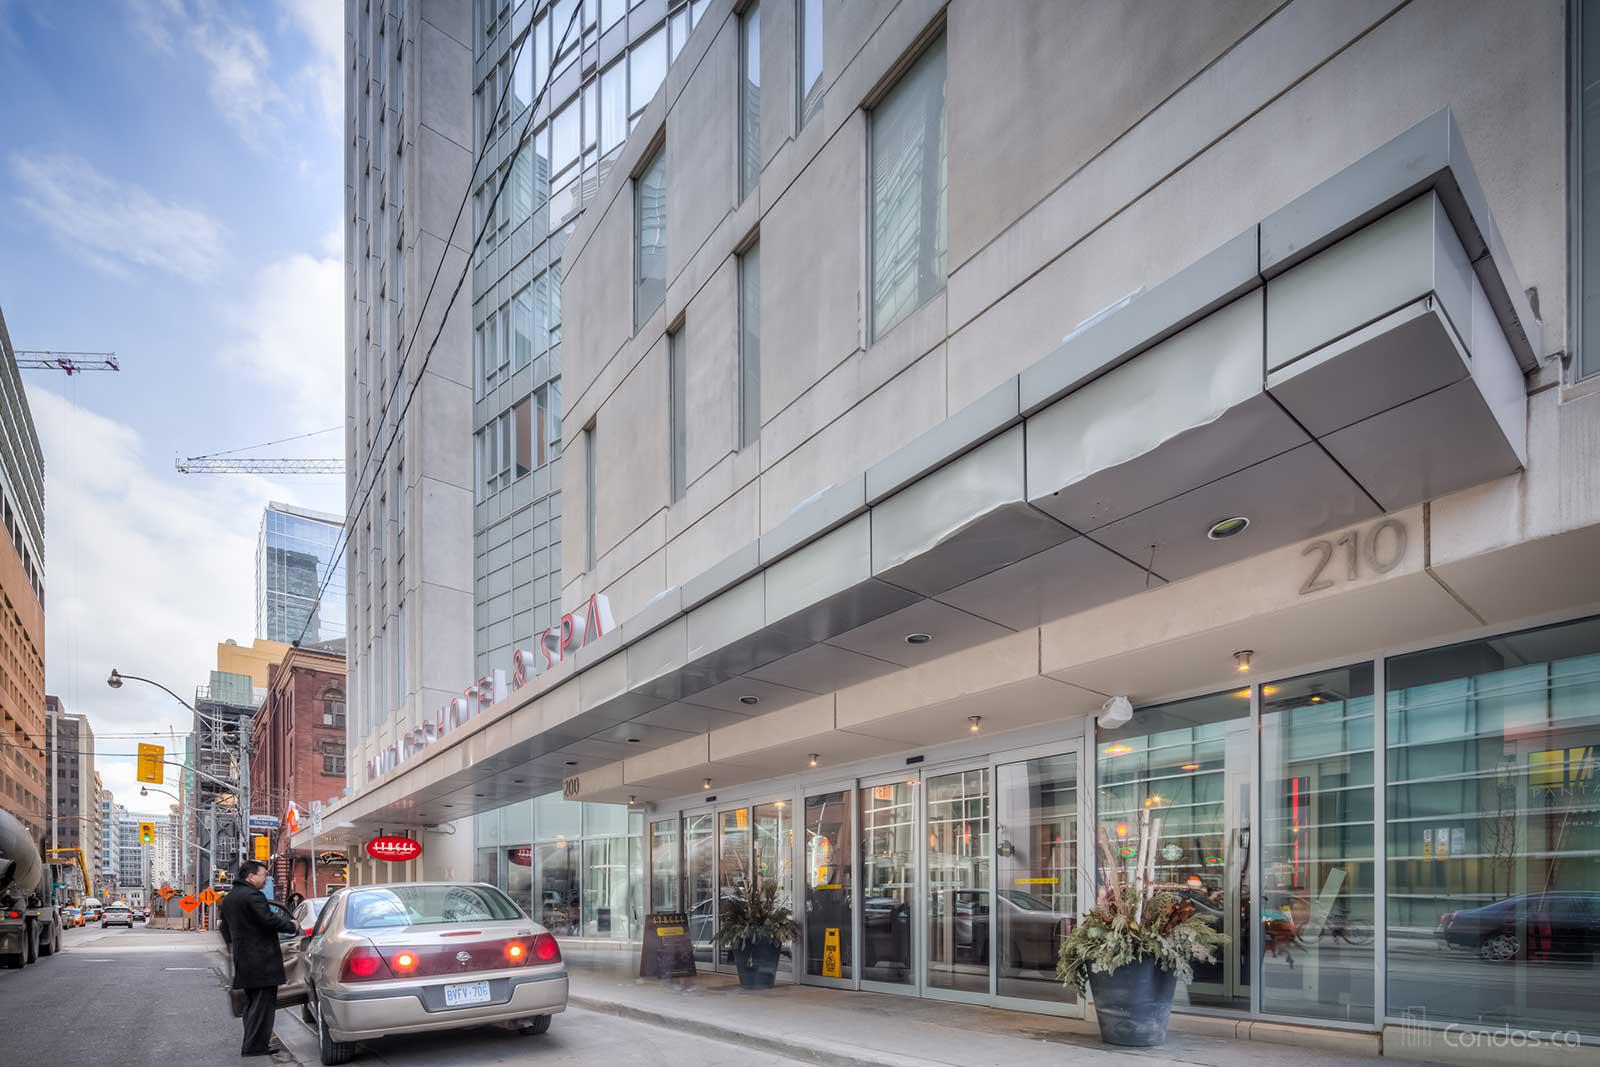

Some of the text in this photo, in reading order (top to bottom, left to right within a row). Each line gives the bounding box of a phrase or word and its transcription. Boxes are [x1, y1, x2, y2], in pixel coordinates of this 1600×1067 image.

[1299, 518, 1408, 595] 210
[512, 649, 536, 692] &
[541, 592, 616, 670] SPA
[563, 777, 580, 797] 200
